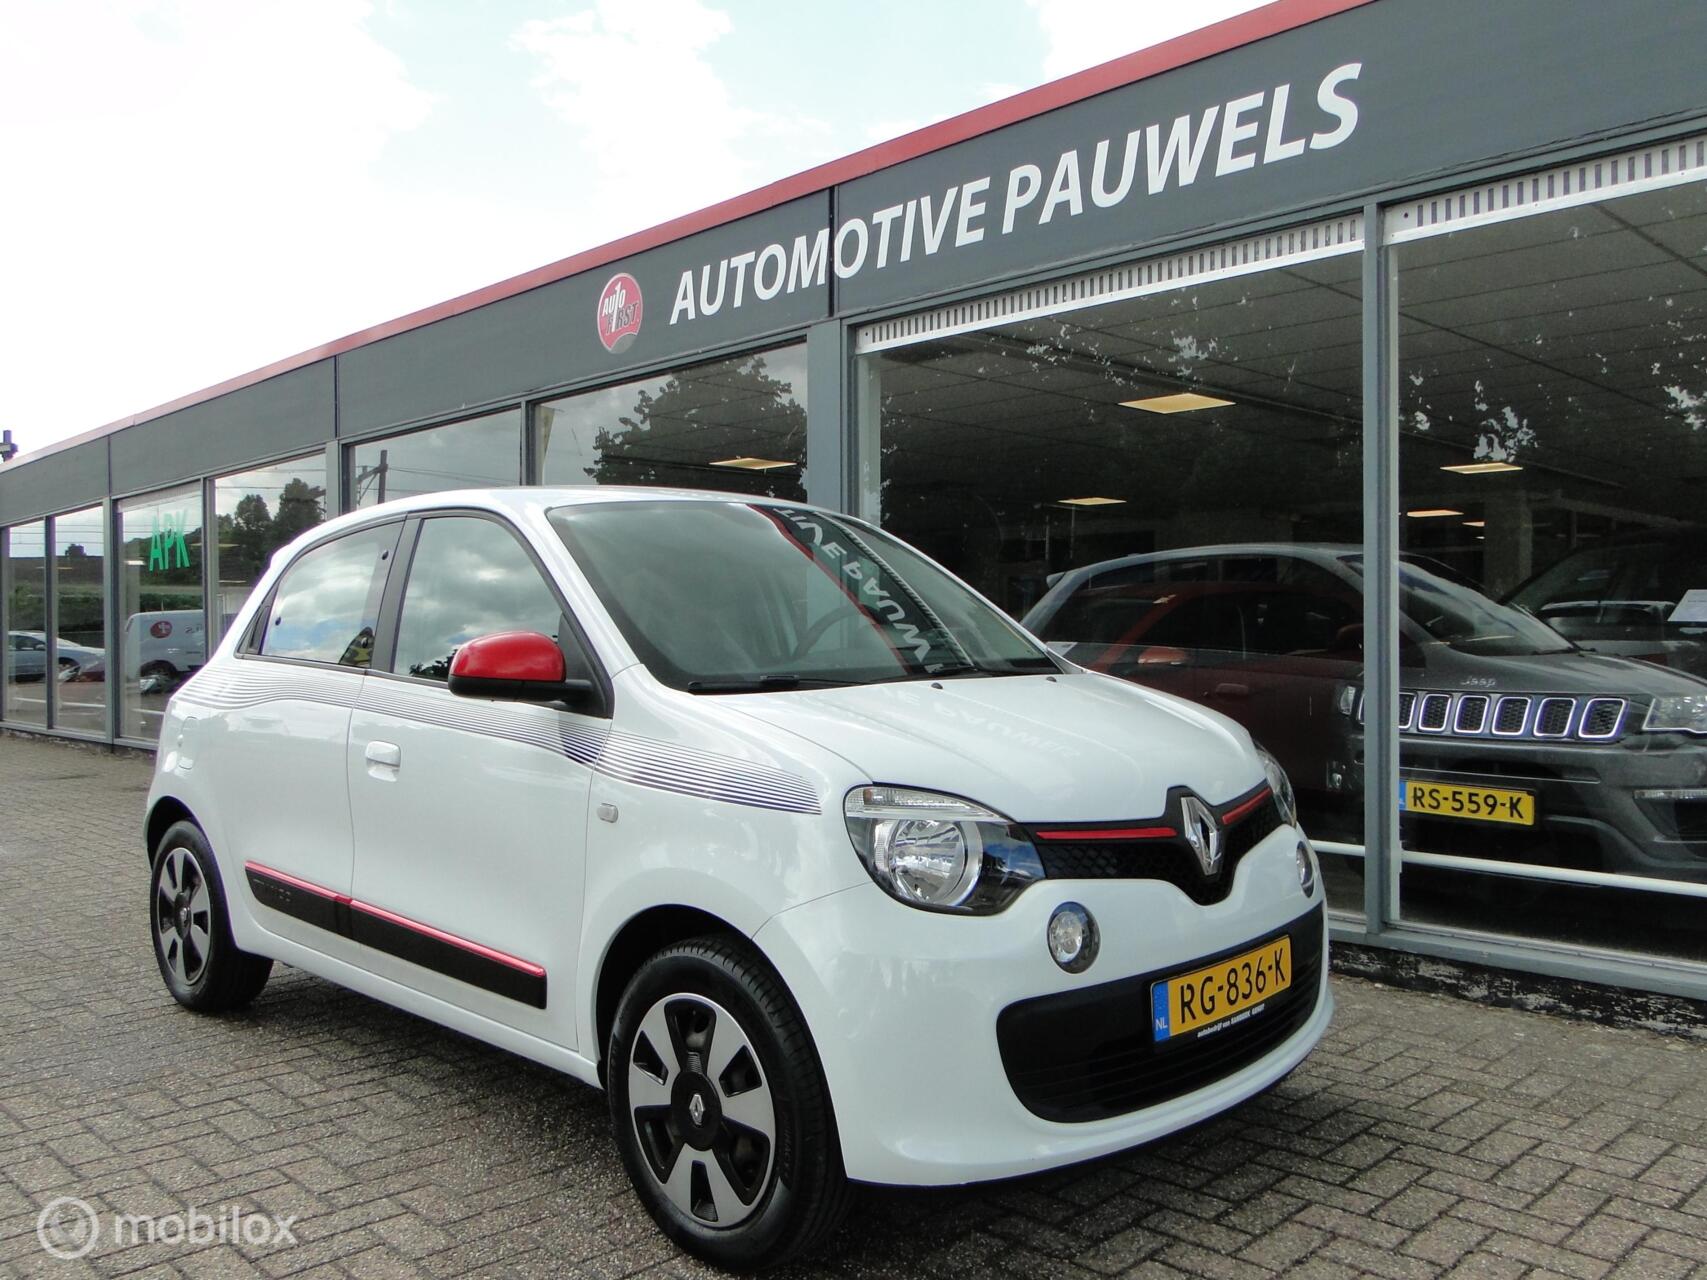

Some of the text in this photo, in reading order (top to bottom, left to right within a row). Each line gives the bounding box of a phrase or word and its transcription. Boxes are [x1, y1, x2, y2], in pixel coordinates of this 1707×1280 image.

[669, 62, 1362, 326] AUTOMOTIVE PAUWELS
[149, 508, 191, 572] APK
[1412, 786, 1524, 820] RS-559-K
[1180, 948, 1286, 1024] RG-836-K
[1155, 1017, 1168, 1031] NL
